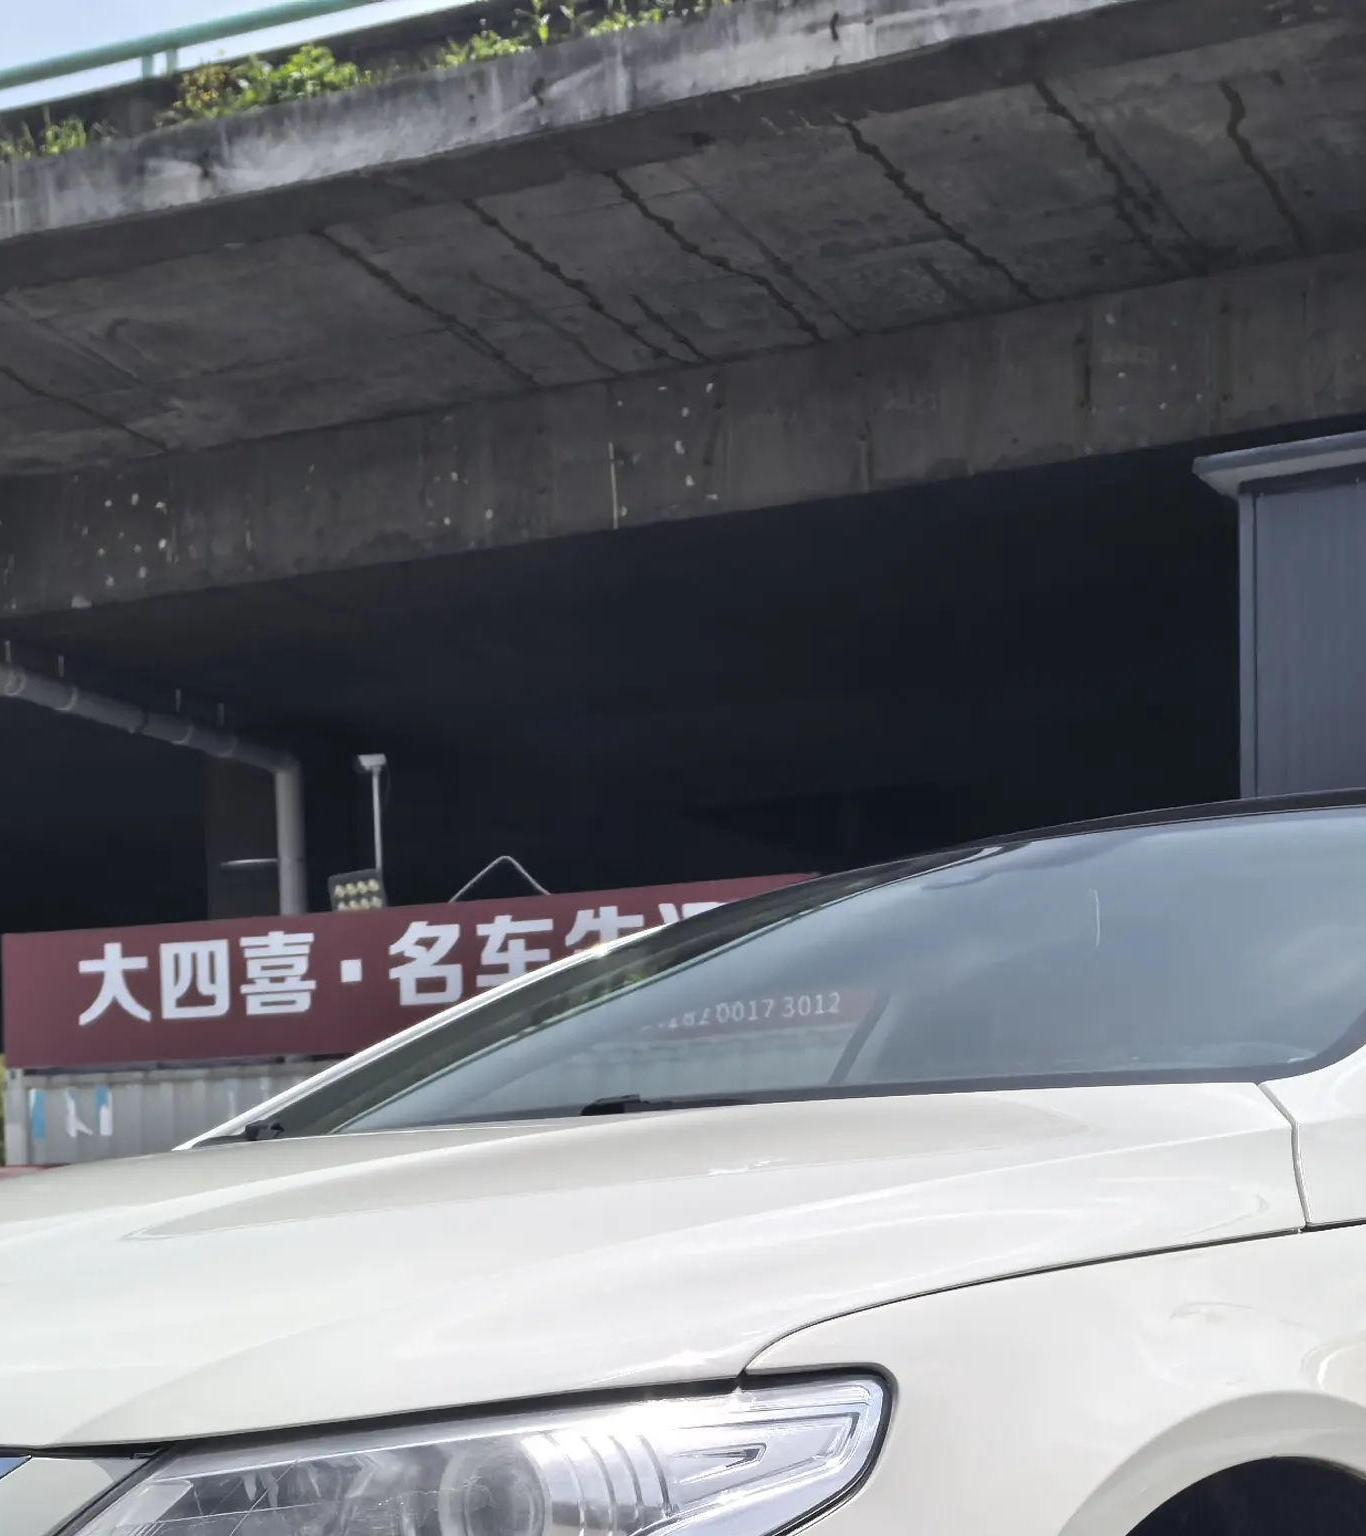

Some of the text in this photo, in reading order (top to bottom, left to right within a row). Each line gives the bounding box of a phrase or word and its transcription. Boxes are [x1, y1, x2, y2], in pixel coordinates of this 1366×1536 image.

[78, 902, 727, 1027] 大四喜·名车
[782, 991, 841, 1019] 3012
